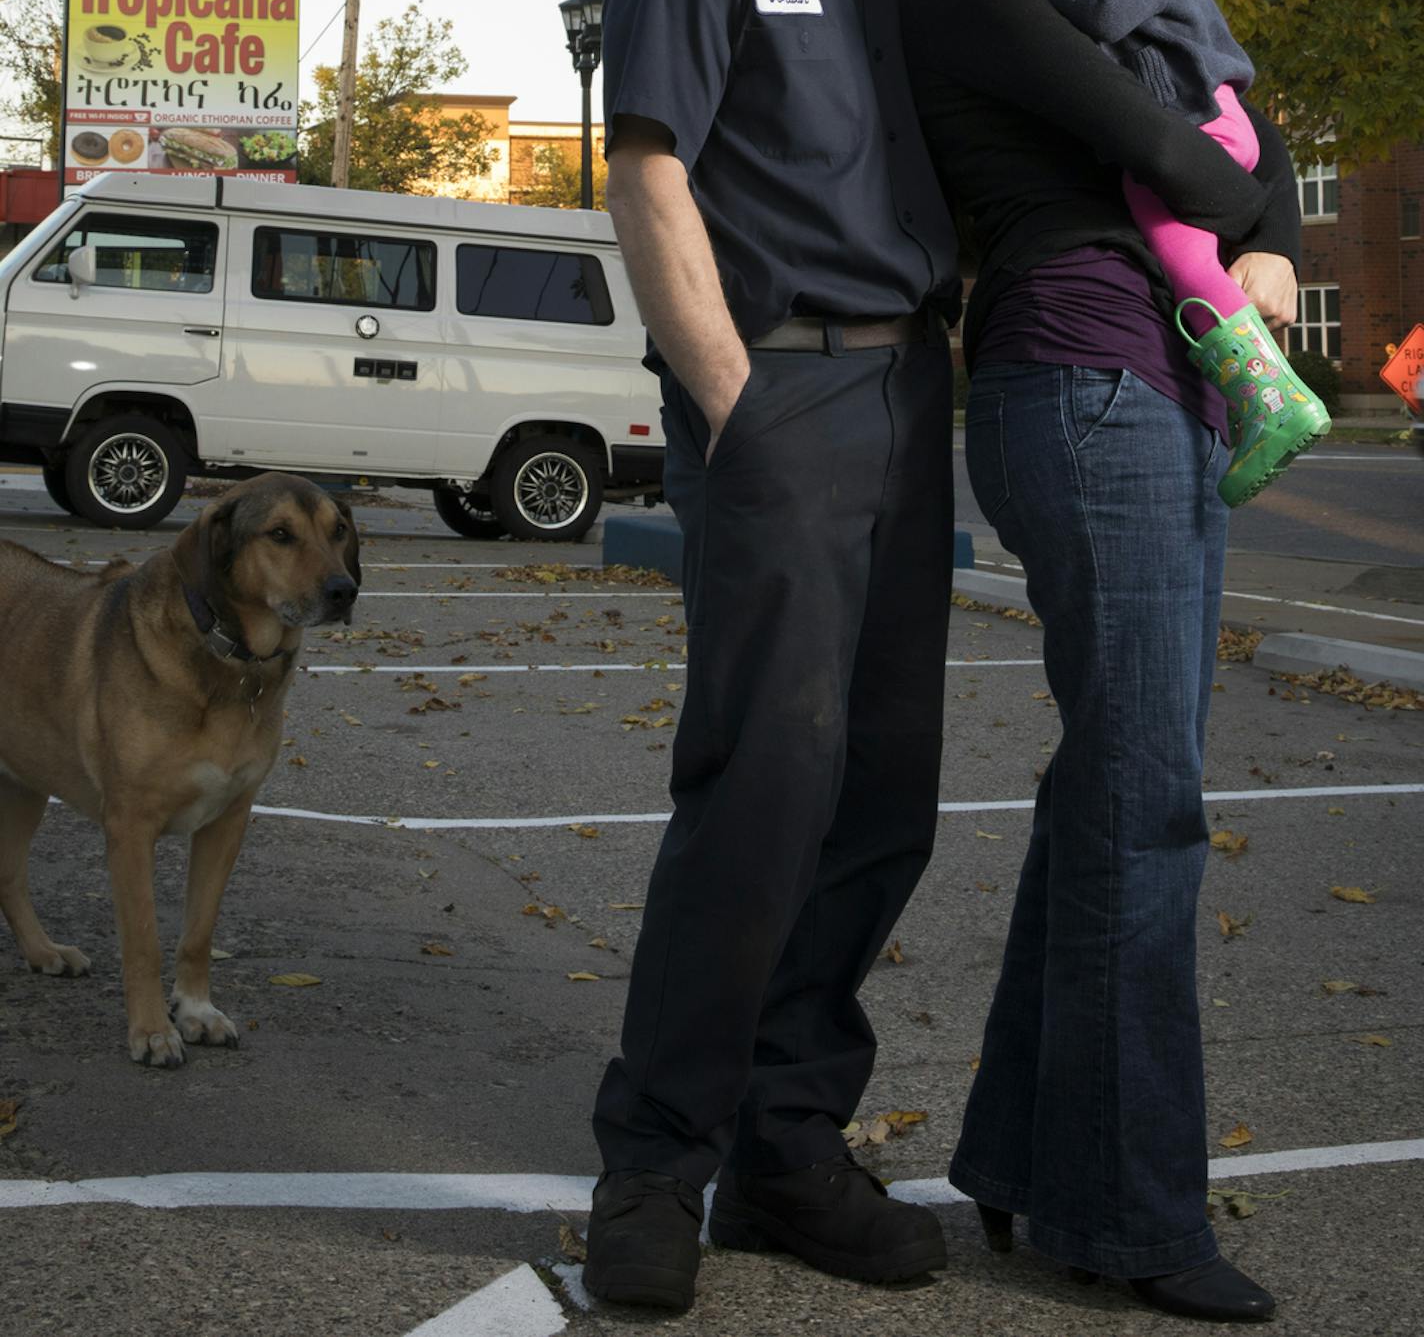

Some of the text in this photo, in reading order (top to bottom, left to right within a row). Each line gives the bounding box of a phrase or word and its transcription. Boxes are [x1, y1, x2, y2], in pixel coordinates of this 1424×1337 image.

[164, 21, 265, 76] Cafe
[154, 113, 292, 125] ORGANIC ETHIOPIAN COFFEE
[1404, 348, 1424, 360] RIG
[1408, 364, 1423, 376] LA
